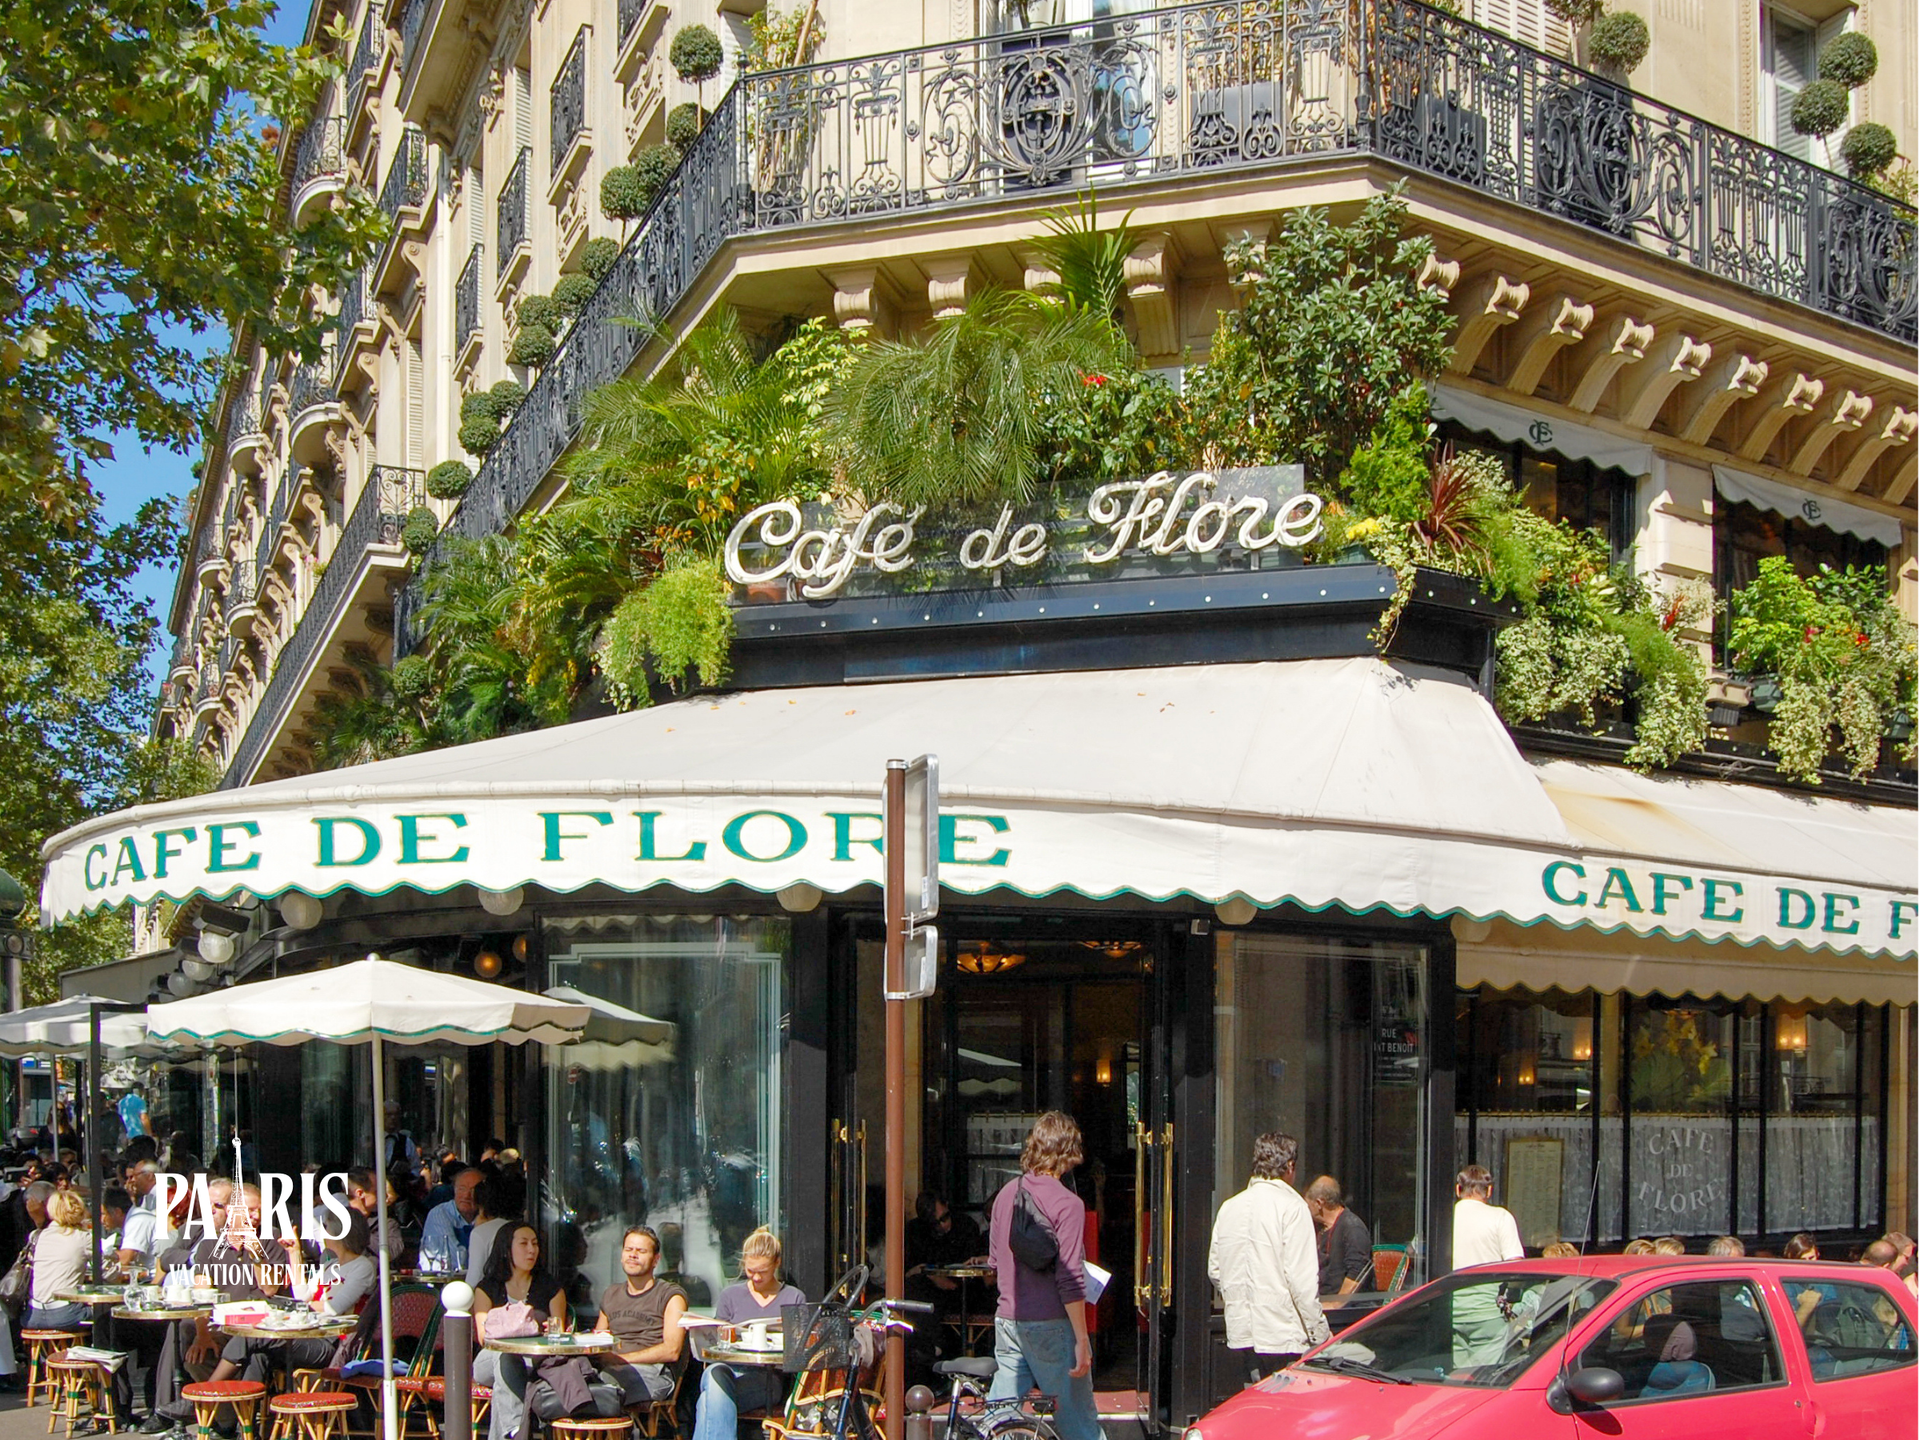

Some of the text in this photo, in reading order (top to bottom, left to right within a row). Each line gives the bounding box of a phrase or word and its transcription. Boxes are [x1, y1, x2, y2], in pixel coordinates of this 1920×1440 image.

[724, 470, 1324, 599] Café de Flore
[84, 809, 1013, 892] CAFE DE FLORE
[1541, 860, 1745, 924] CAFE
[1775, 886, 1861, 935] DE
[1381, 1028, 1397, 1038] RUE
[1648, 1127, 1714, 1155] CAFE
[1668, 1163, 1694, 1179] DE
[1638, 1178, 1723, 1214] FLORE
